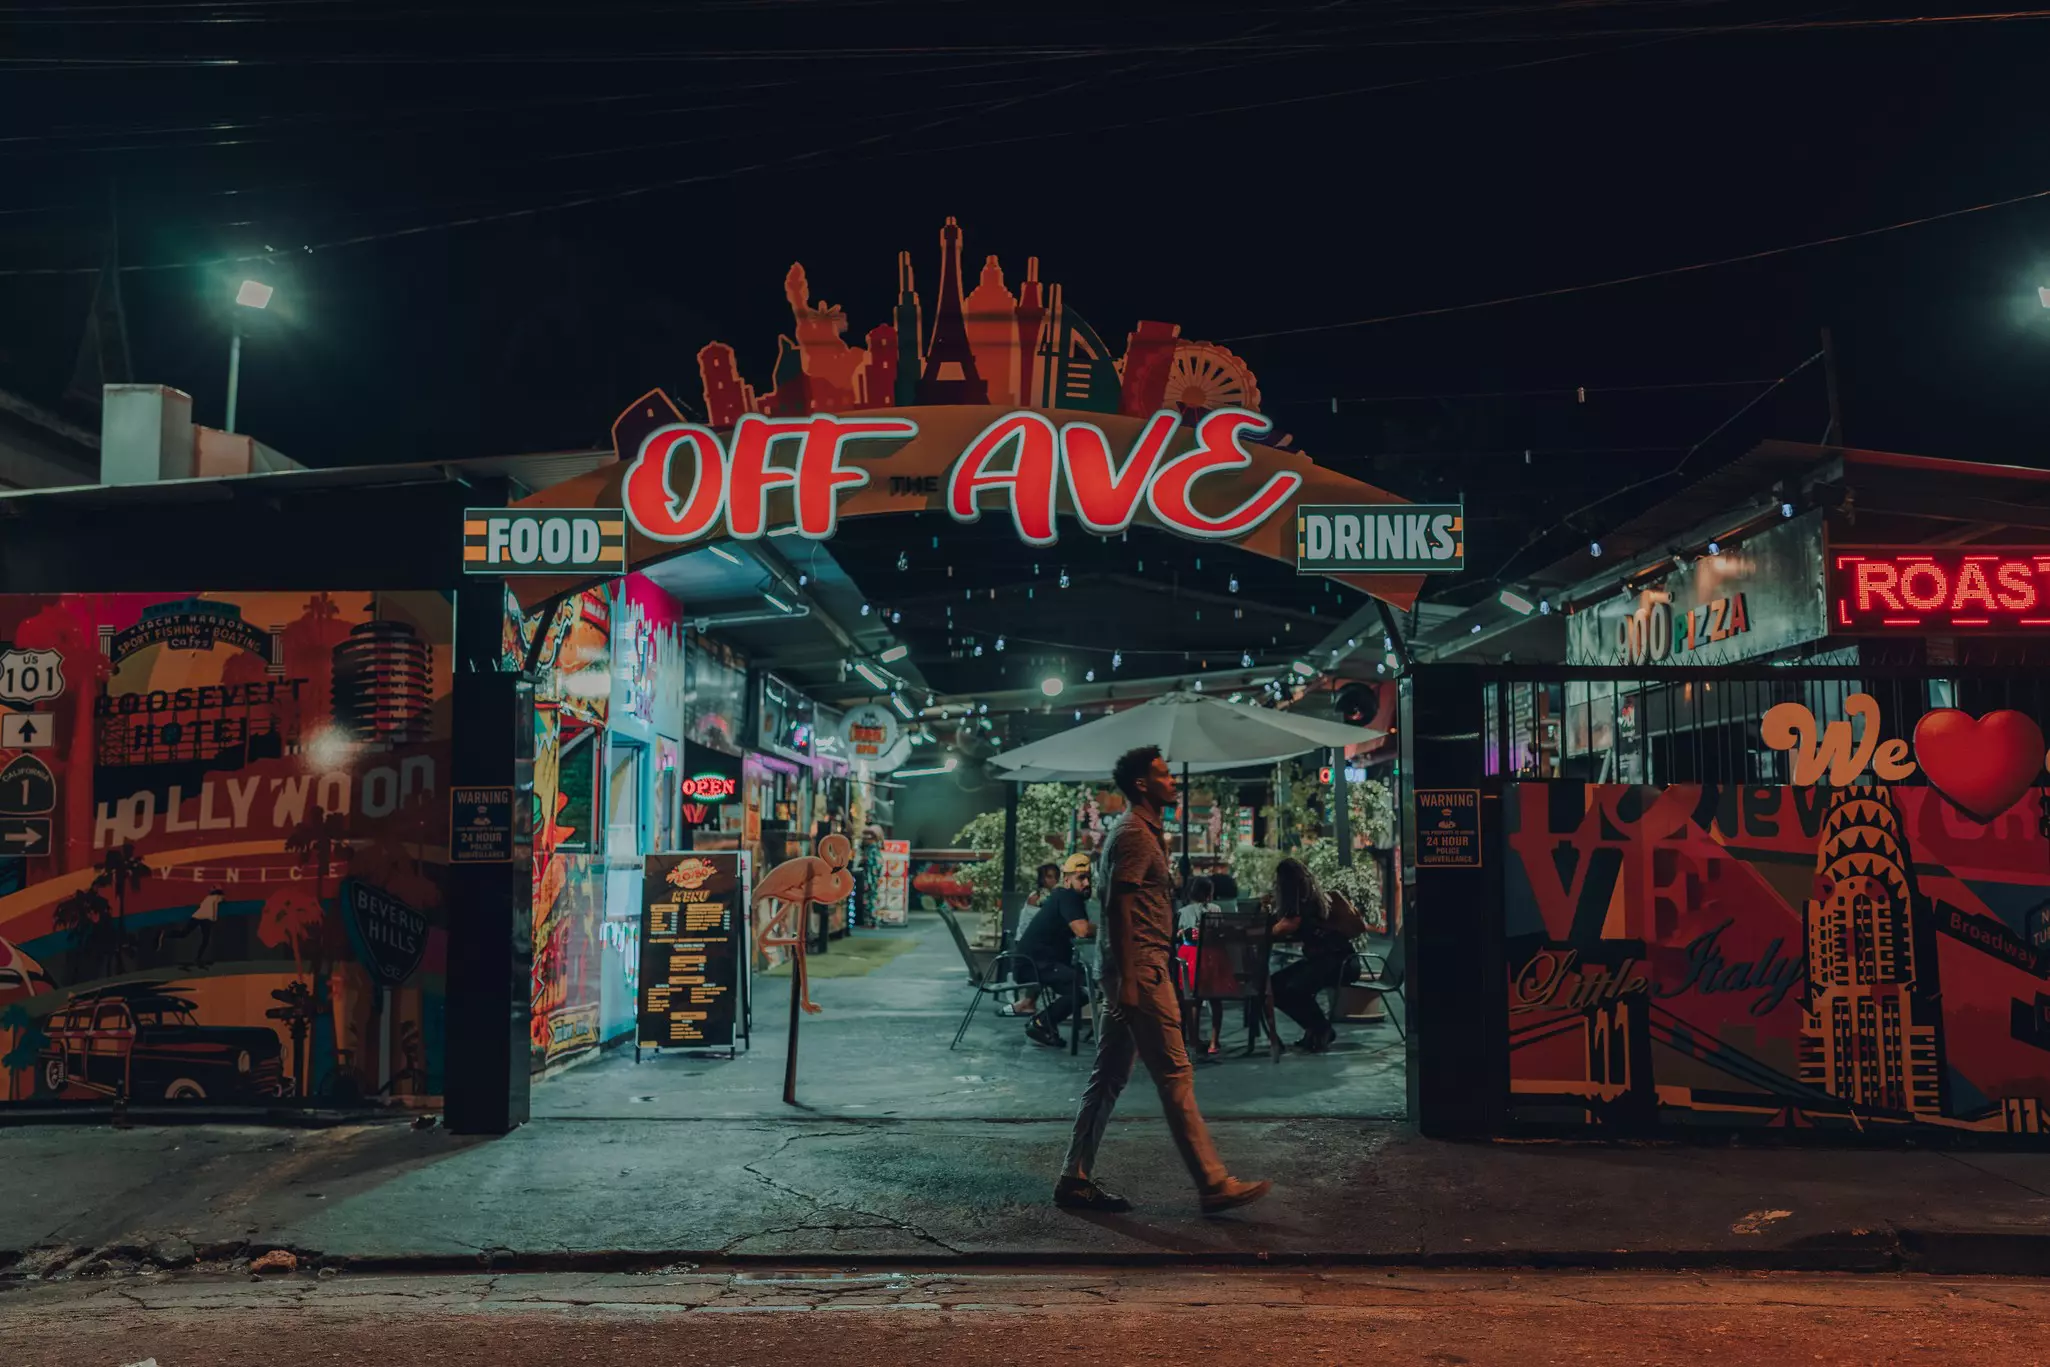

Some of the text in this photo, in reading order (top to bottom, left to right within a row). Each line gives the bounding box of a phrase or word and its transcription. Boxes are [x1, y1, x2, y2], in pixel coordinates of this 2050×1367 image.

[622, 406, 1303, 547] OFF THE AVE
[487, 517, 601, 565] FOOD
[1306, 514, 1456, 562] DRINKS
[137, 616, 181, 631] YACHT
[1673, 592, 1750, 654] PIZZA
[117, 624, 262, 656] SPORT FISHING BOATING
[7, 666, 54, 693] 101
[1761, 692, 1917, 788] We
[2, 767, 50, 783] CALIFORNIA
[682, 777, 736, 797] OPEN
[21, 779, 30, 806] 1
[457, 790, 508, 804] WARNING
[1420, 794, 1473, 807] WARNING
[461, 832, 502, 842] 24 HOUR
[1426, 836, 1468, 846] 24 HOUR
[161, 864, 339, 884] VENICE
[357, 888, 424, 936] BEVERLY
[368, 918, 417, 955] HILLS
[1950, 891, 2038, 970] Broadway
[1509, 917, 1805, 1017] Little Italy
